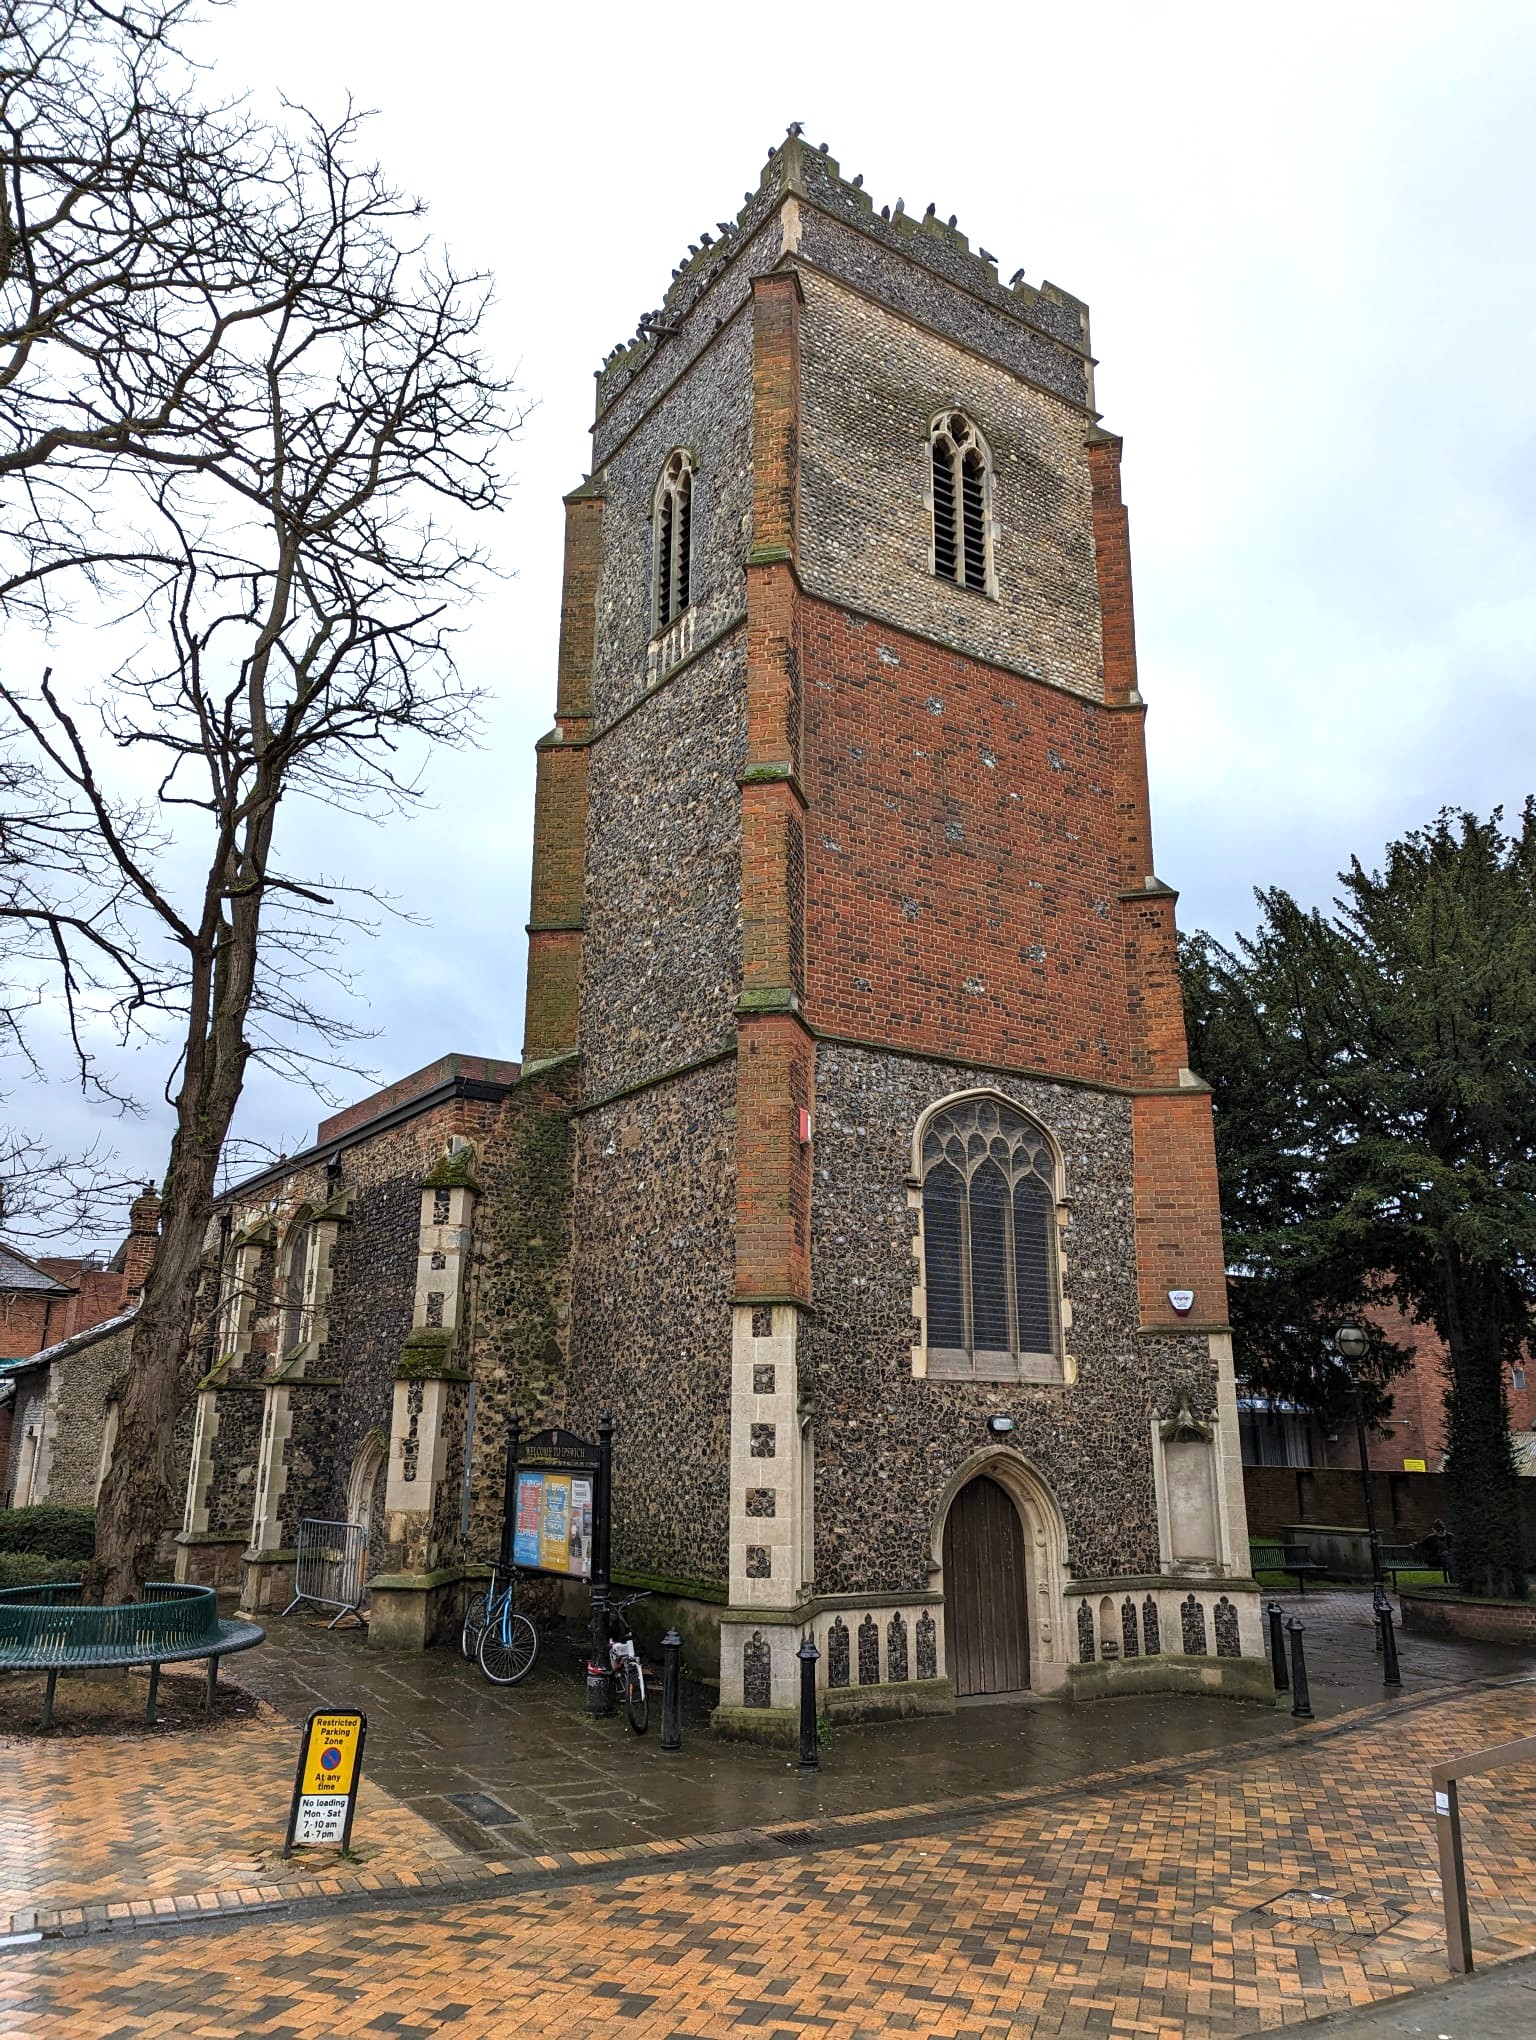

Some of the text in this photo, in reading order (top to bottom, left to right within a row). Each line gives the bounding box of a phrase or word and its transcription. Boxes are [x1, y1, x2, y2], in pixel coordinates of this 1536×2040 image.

[526, 1446, 585, 1458] WELCOME TO IPSWICH
[317, 1718, 357, 1726] Restricted
[321, 1728, 350, 1737] Parking
[324, 1737, 343, 1745] Zone
[315, 1773, 341, 1782] At any
[318, 1782, 335, 1791] time
[303, 1799, 346, 1808] No loading
[304, 1810, 320, 1818] Mon
[327, 1810, 341, 1818] Sat
